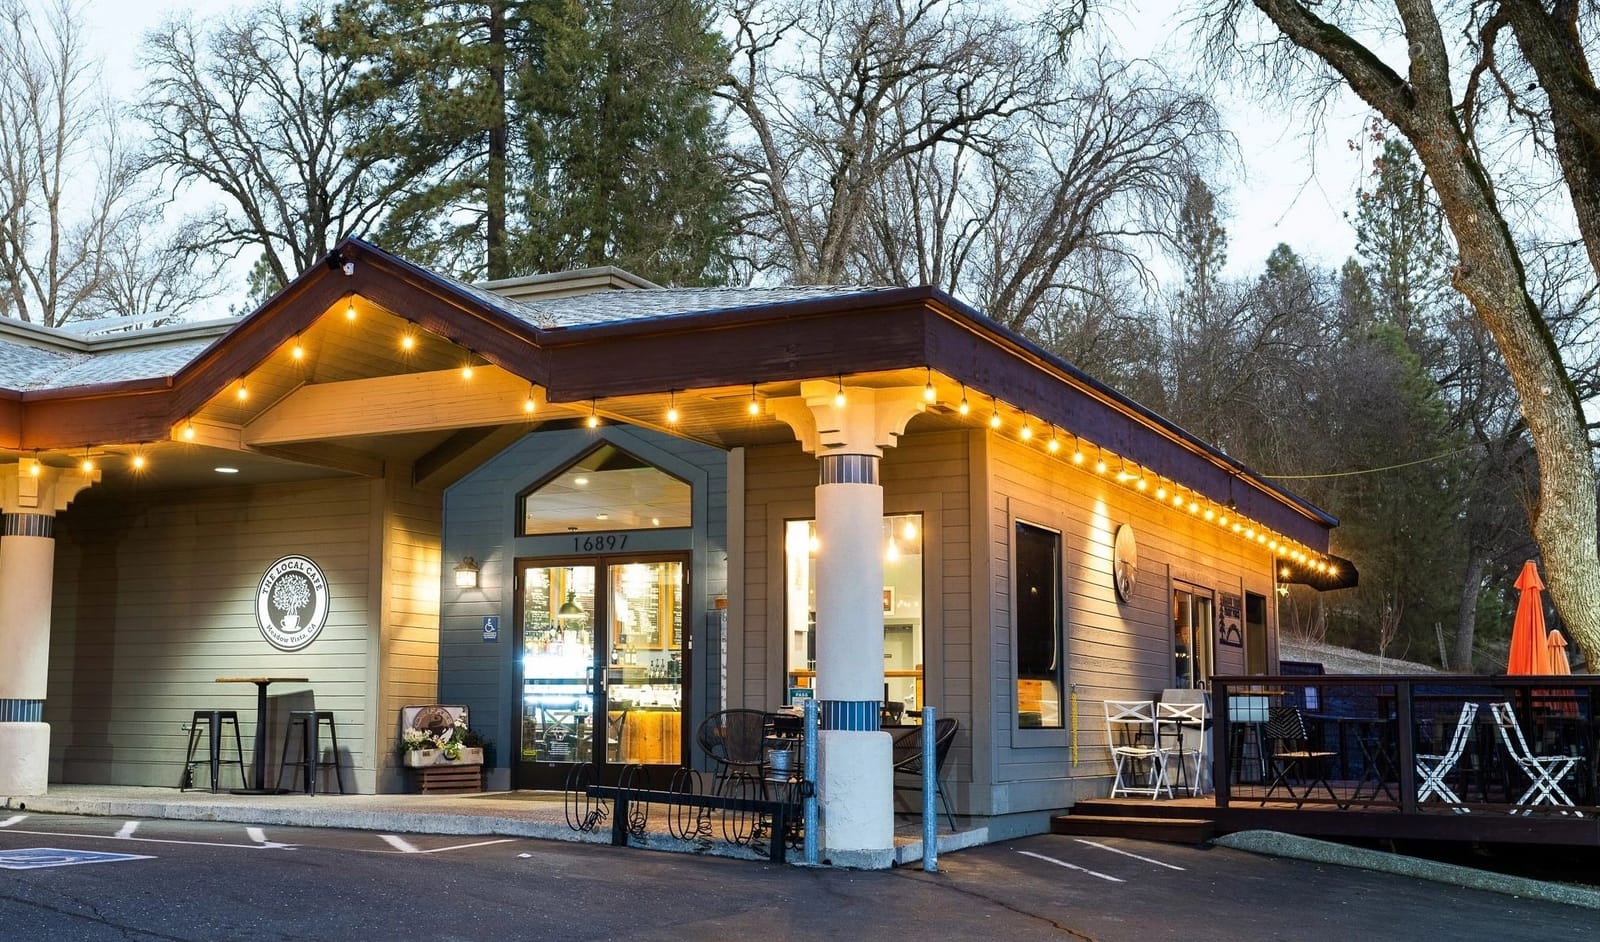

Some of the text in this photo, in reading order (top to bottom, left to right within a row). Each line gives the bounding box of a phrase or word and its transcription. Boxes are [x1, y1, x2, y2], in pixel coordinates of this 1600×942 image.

[574, 534, 628, 552] 16897
[262, 574, 276, 595] THE
[275, 561, 304, 574] LOCAL
[266, 624, 289, 643] Meadow
[307, 623, 317, 633] CA
